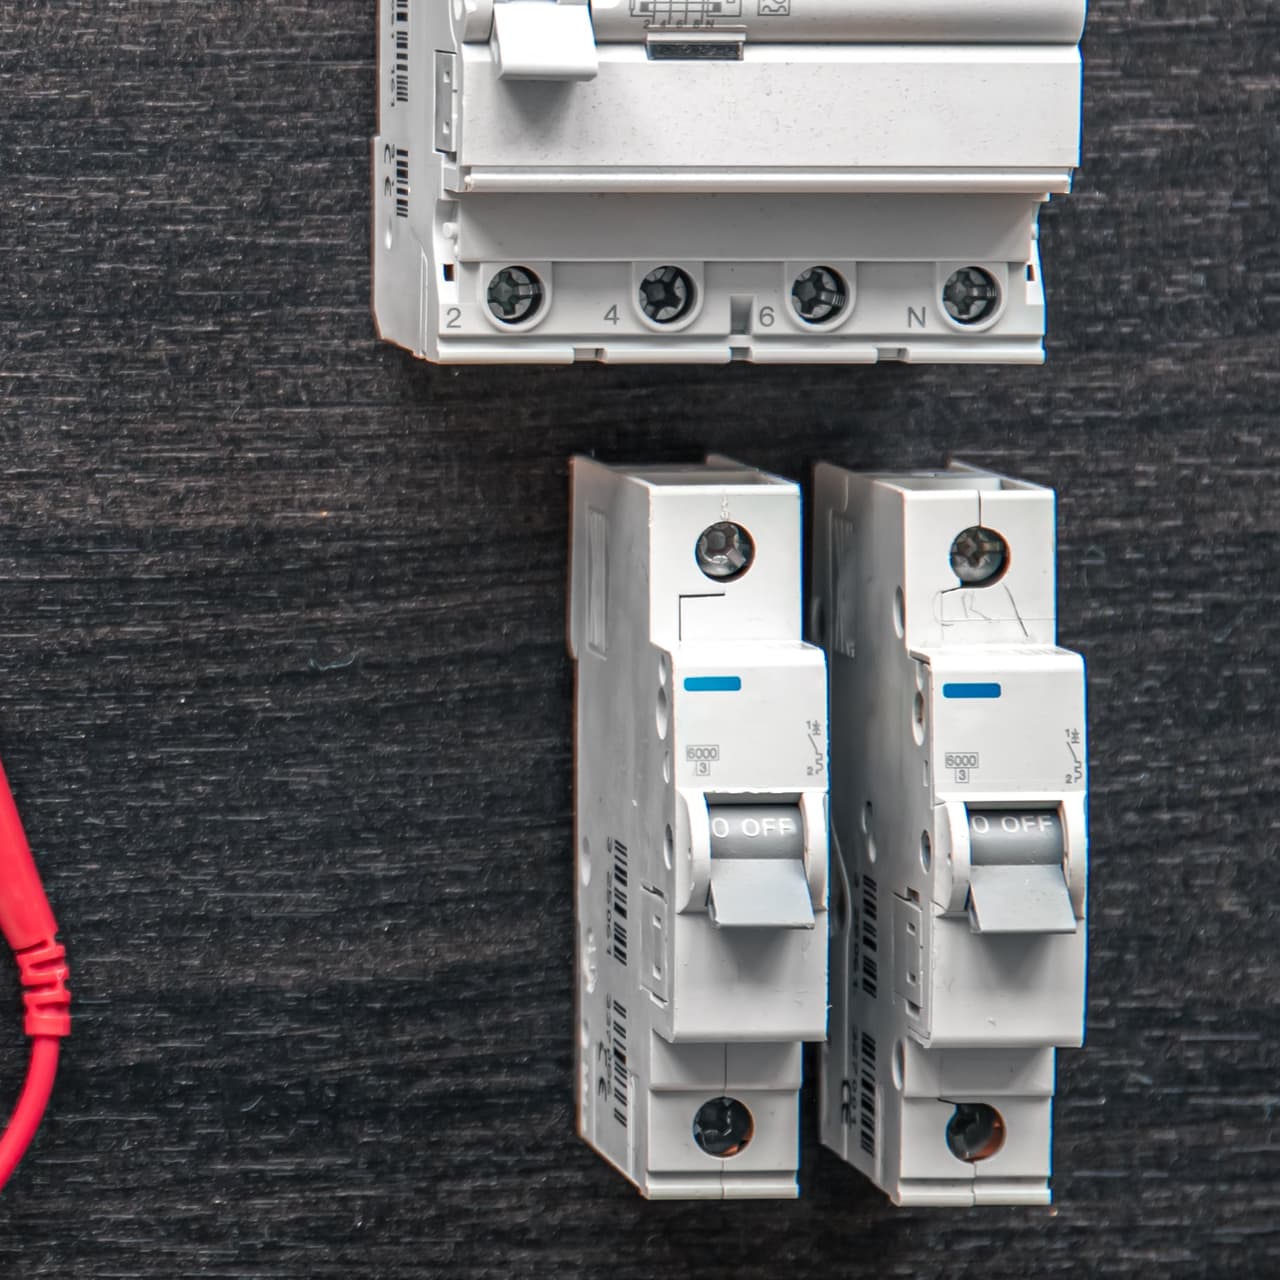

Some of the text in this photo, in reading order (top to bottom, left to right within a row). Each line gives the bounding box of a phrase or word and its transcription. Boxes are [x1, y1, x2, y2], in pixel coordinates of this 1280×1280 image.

[447, 304, 925, 328] 2 4 6 N
[688, 748, 717, 759] 6000
[946, 755, 977, 766] 6000
[742, 818, 795, 836] OFF
[1001, 815, 1053, 832] OFF
